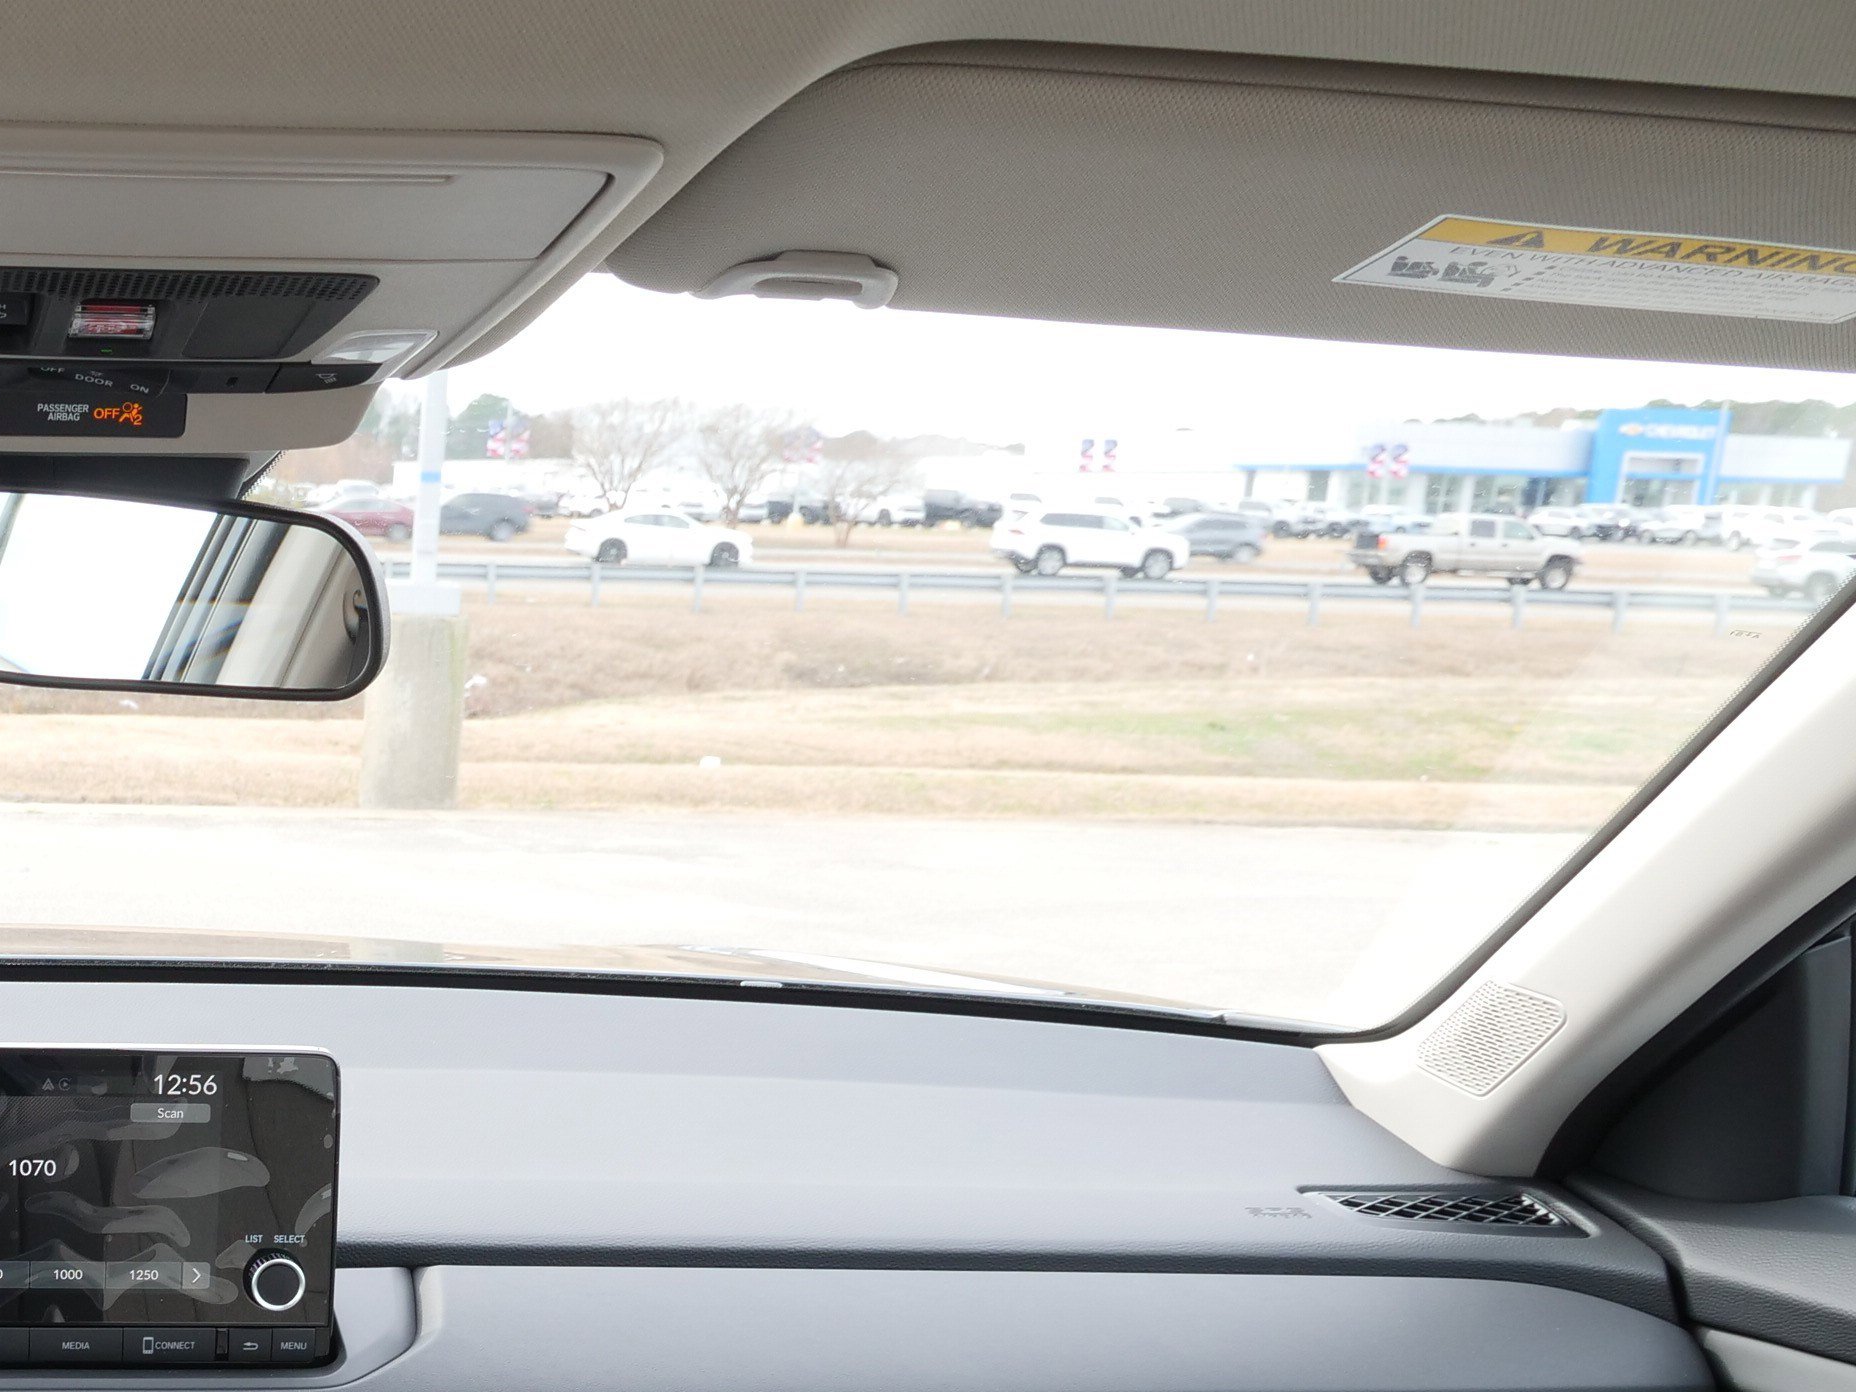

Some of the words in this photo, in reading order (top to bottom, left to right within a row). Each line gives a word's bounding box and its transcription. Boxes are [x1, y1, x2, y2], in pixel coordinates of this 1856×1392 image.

[1529, 253, 1598, 265] WITH
[1600, 259, 1743, 278] ADVANCED
[1749, 272, 1793, 281] AIR
[74, 373, 114, 388] DOOR
[130, 383, 149, 394] ON
[37, 403, 89, 413] PASSENGER
[94, 407, 120, 420] OFF
[47, 412, 80, 421] AIRBAG
[153, 1074, 218, 1095] 12:56
[157, 1108, 184, 1119] Scan
[7, 1159, 57, 1177] 1070
[245, 1234, 263, 1244] LIST
[273, 1234, 306, 1244] SELECT
[53, 1269, 83, 1280] 1000
[129, 1269, 159, 1281] 1250
[62, 1341, 90, 1350] MEDIA
[155, 1341, 195, 1350] CONNECT
[280, 1341, 307, 1351] MENU
